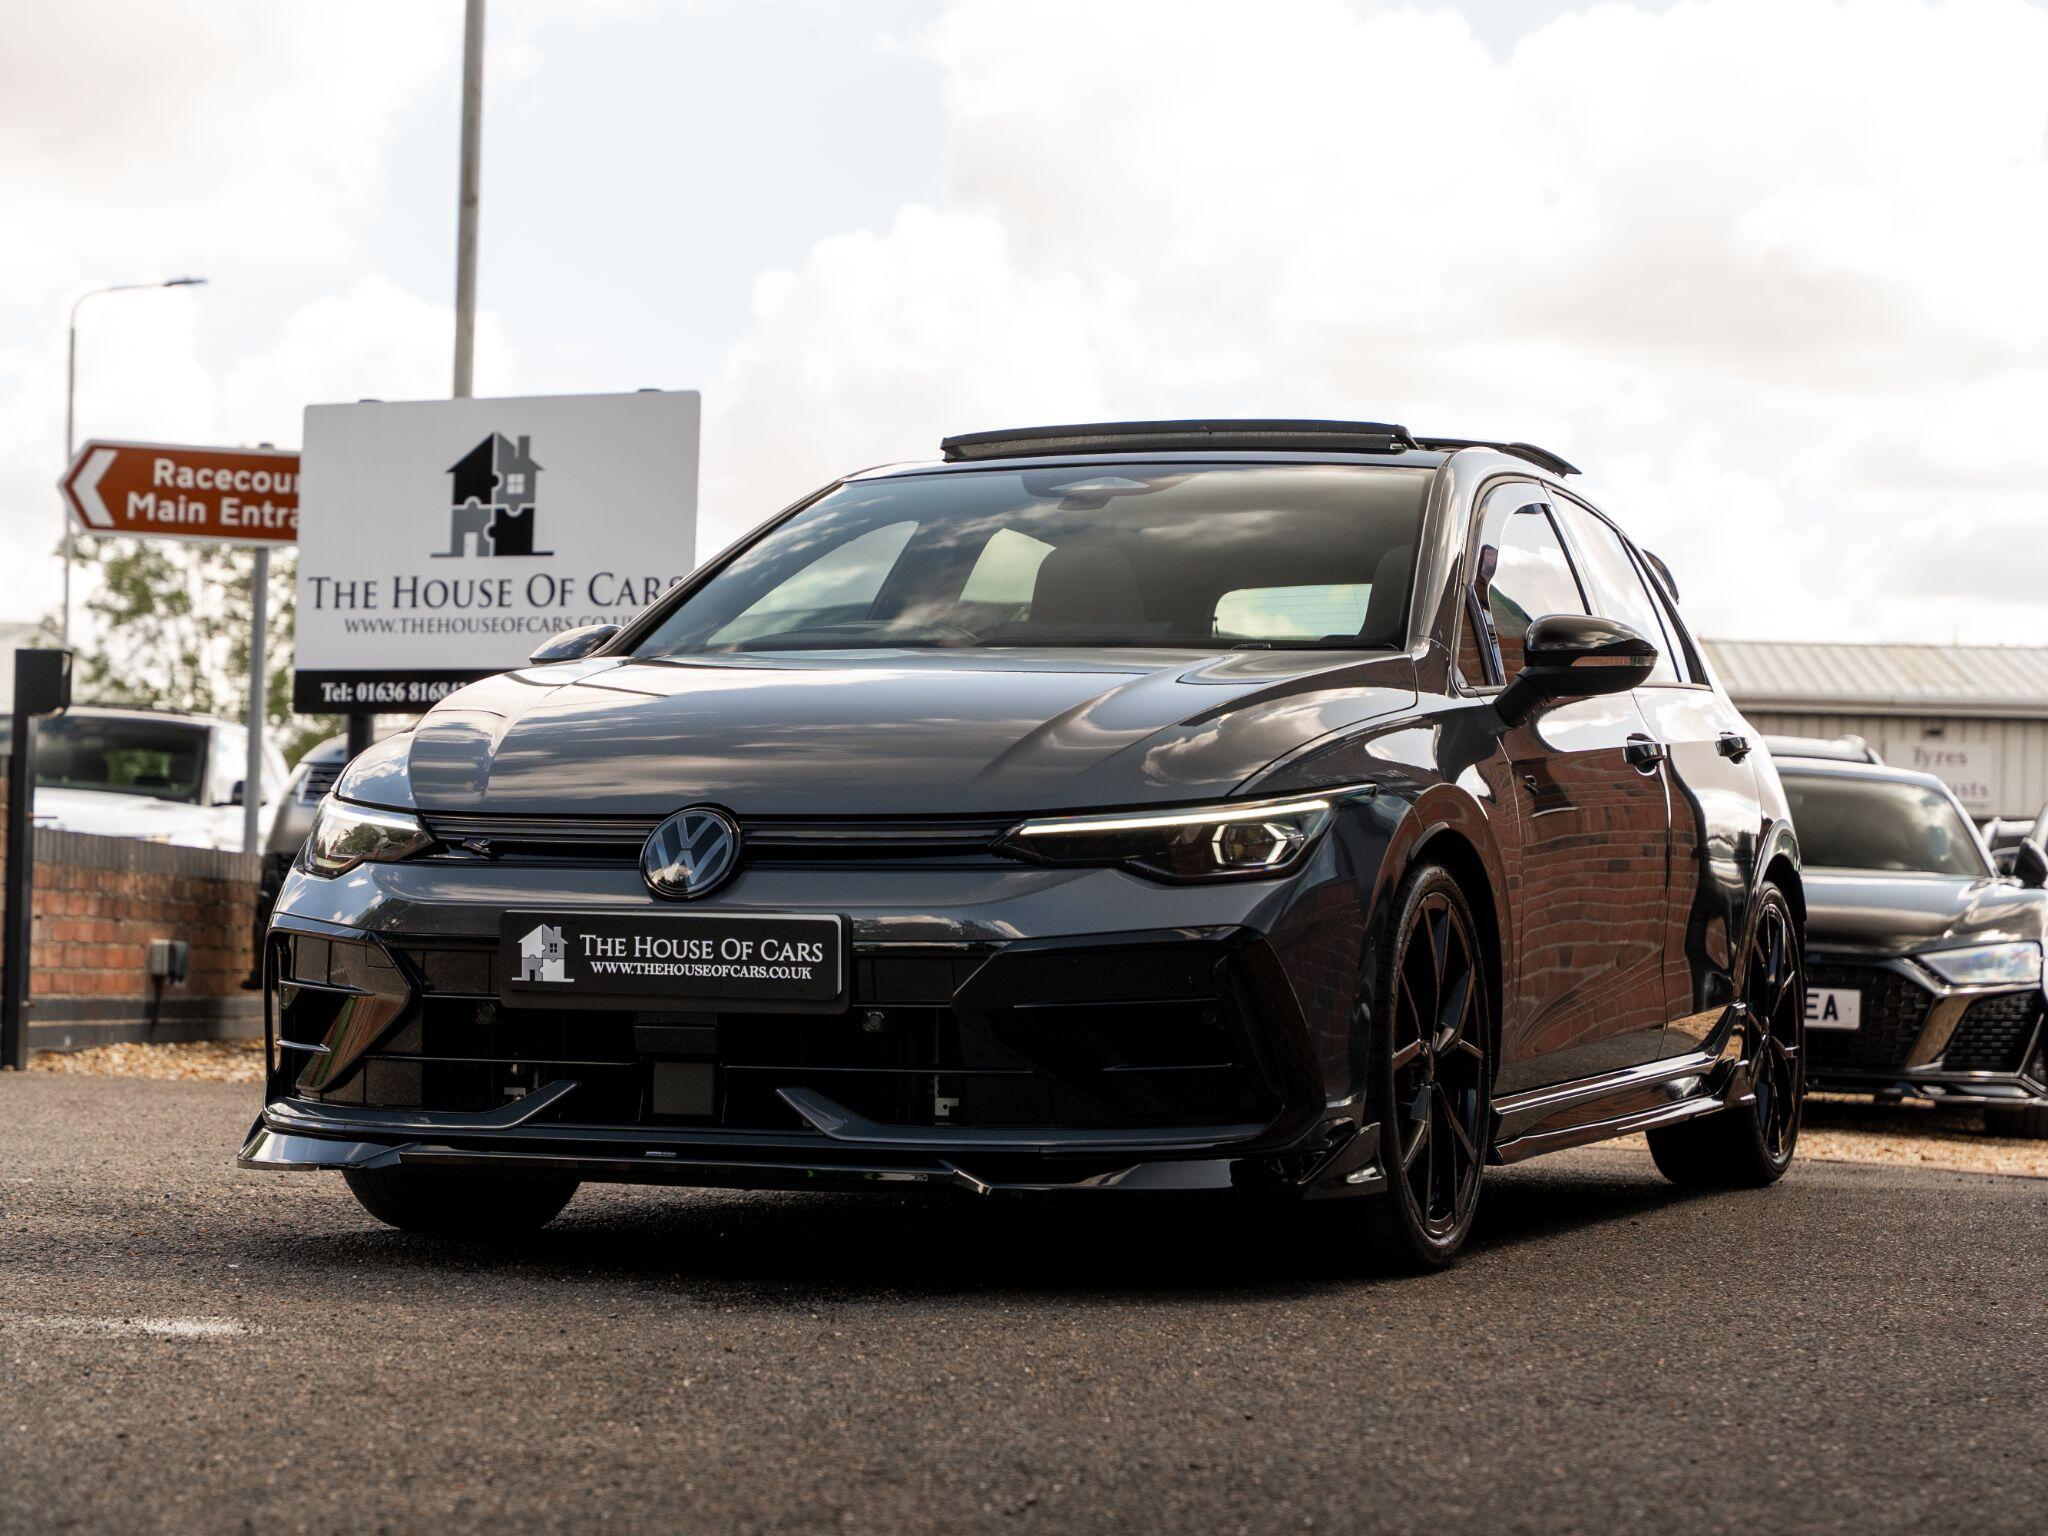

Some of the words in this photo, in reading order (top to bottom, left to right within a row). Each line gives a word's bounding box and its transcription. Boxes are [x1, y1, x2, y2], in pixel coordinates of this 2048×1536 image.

[126, 491, 207, 524] Main
[307, 576, 378, 610] THE
[392, 574, 513, 610] HOUSE
[526, 572, 576, 609] OF
[320, 682, 354, 702] Tel:
[355, 681, 406, 702] 01636
[1911, 745, 1969, 769] Tyres
[579, 934, 628, 957] THE
[633, 936, 715, 960] HOUSE
[721, 938, 754, 961] OF
[760, 939, 824, 963] CARS
[590, 961, 812, 979] WWW.THEHOUSEOFCARS.CO.UK
